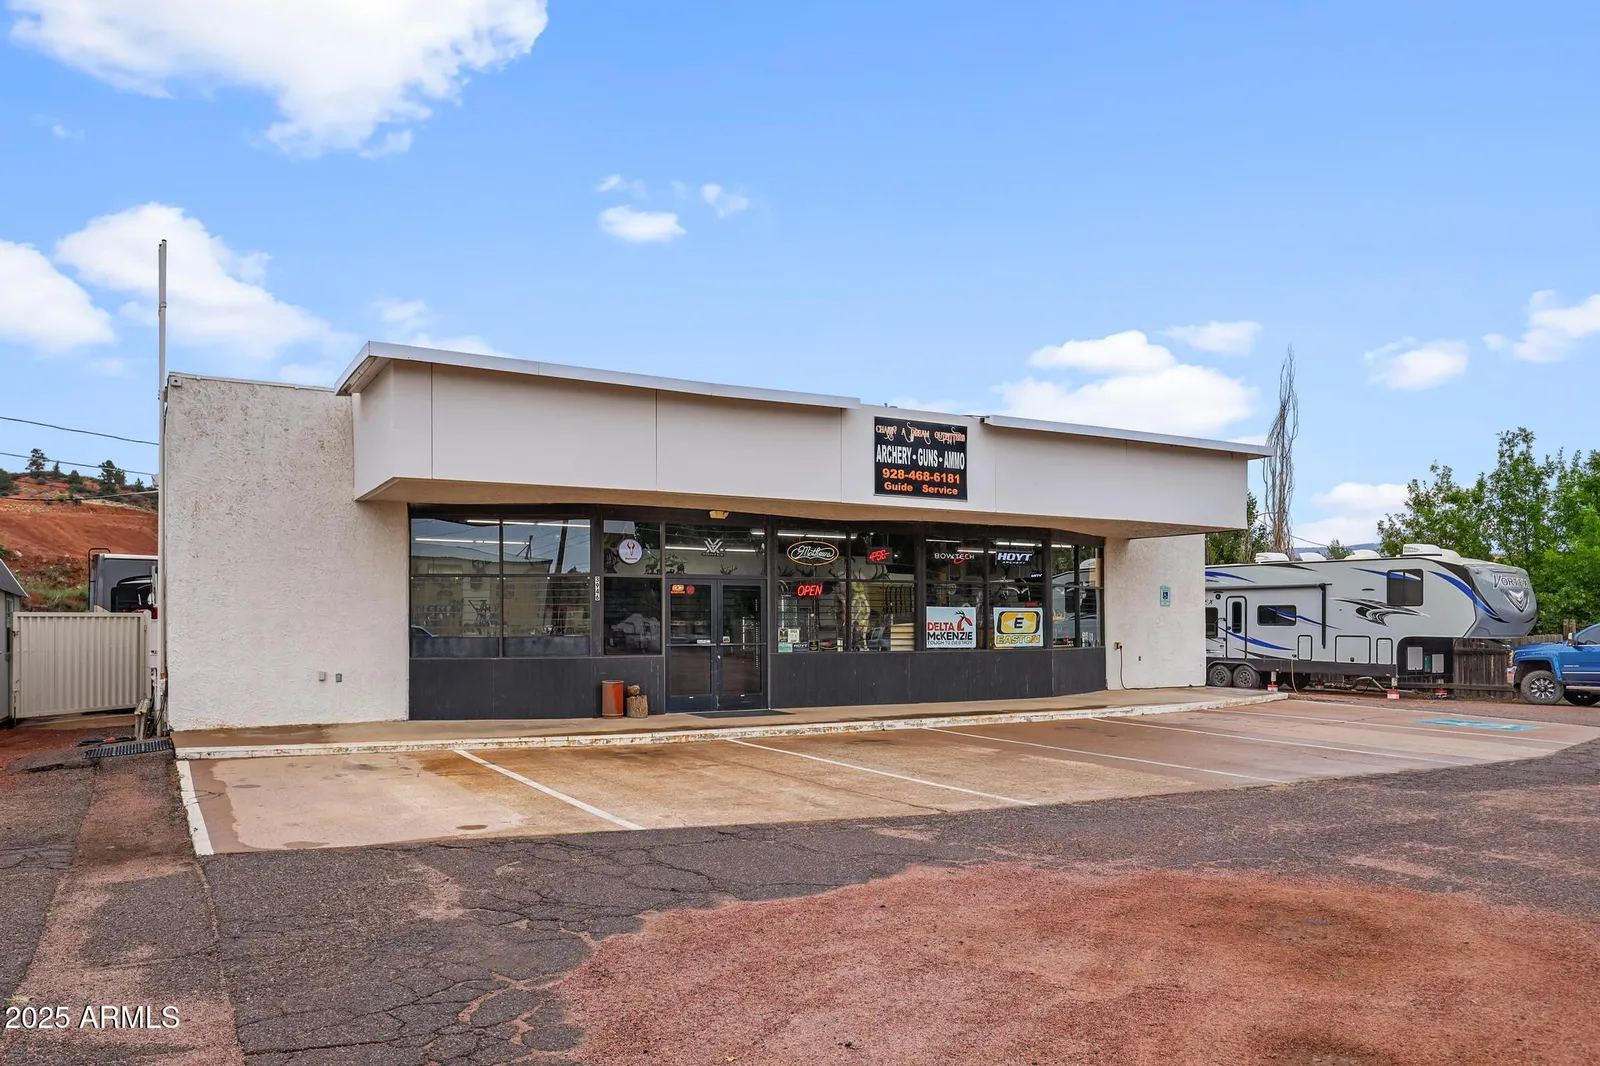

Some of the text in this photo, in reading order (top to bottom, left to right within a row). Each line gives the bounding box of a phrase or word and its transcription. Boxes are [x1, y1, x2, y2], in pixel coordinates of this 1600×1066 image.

[876, 444, 965, 470] ARCHERY GUNS AMMO
[882, 468, 960, 484] 928-468-6181
[884, 481, 958, 495] Guide Service
[934, 552, 975, 560] BOWTECH
[997, 552, 1033, 561] HOYT
[797, 583, 823, 597] OPEN
[927, 622, 955, 631] DELTA
[1014, 617, 1024, 629] E
[927, 632, 973, 640] McKENZIE
[996, 635, 1040, 644] EASTON
